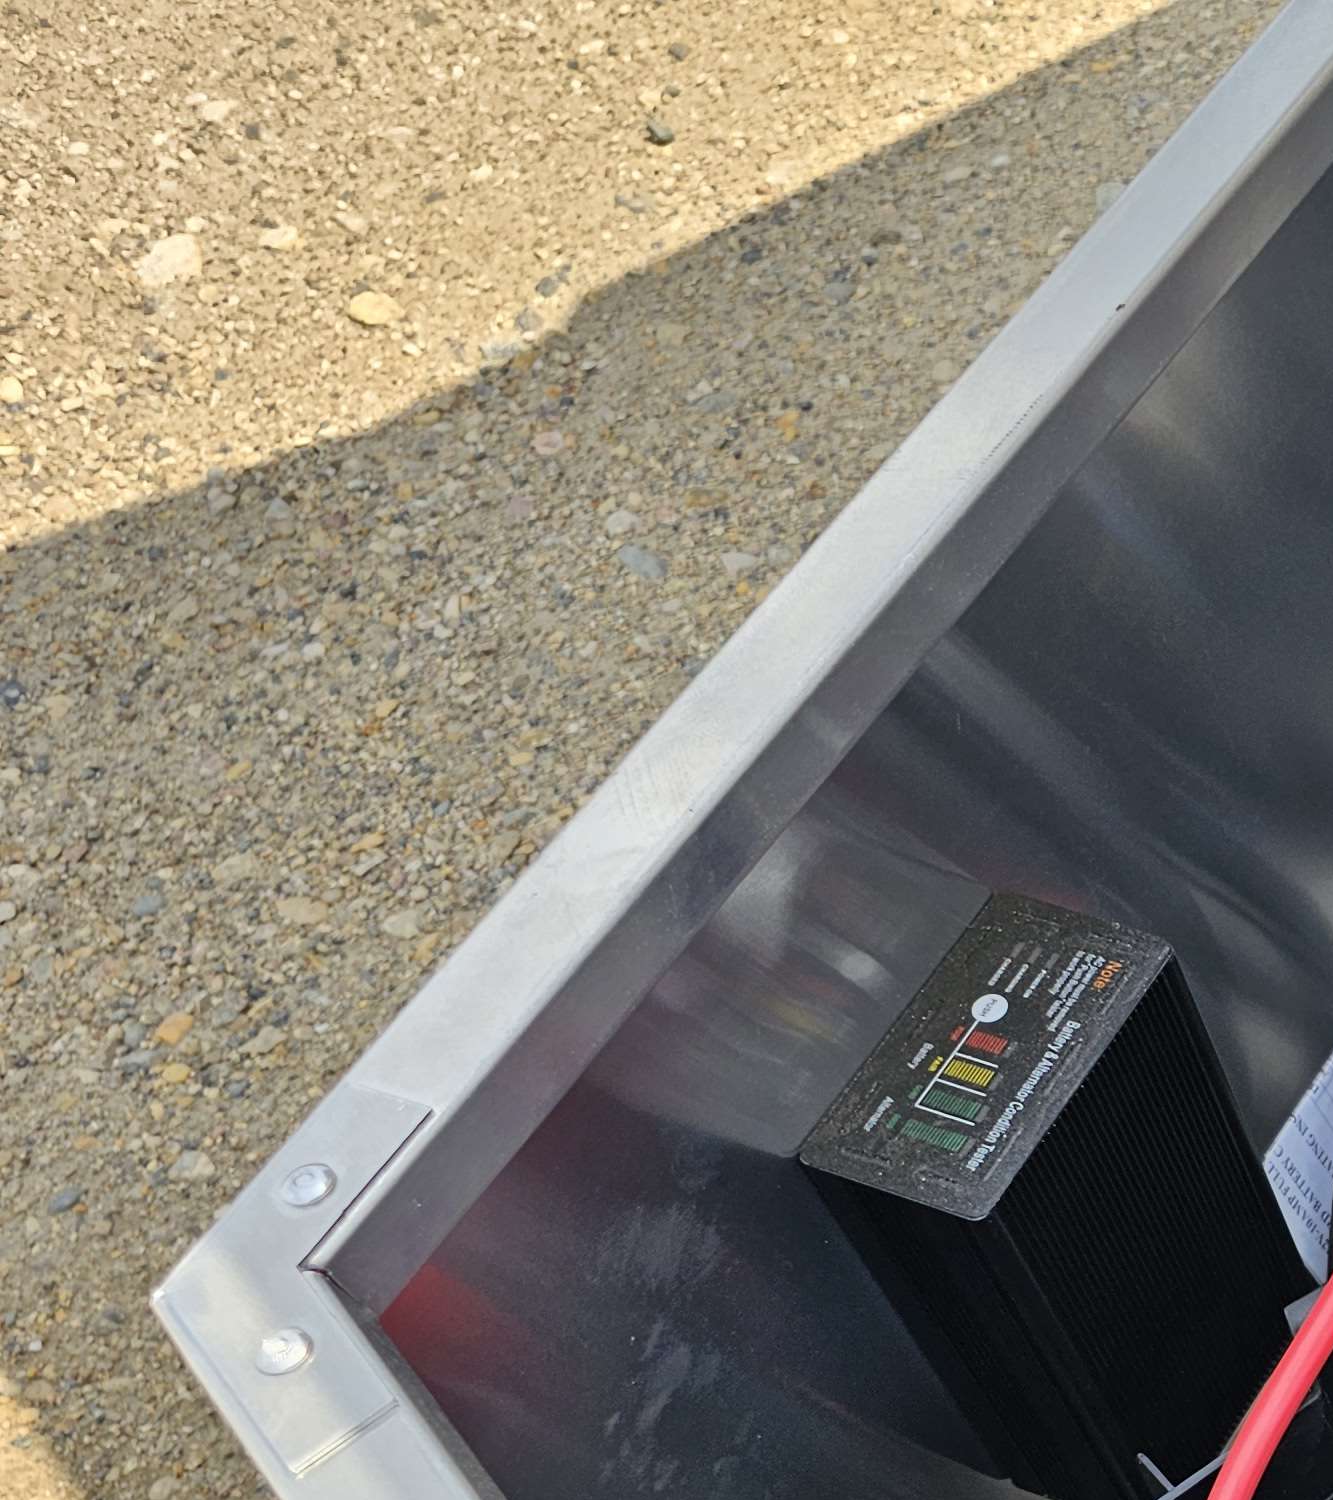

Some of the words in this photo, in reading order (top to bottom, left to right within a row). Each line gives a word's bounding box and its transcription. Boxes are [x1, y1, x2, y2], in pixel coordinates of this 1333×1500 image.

[1088, 959, 1122, 993] Note:
[1044, 1018, 1081, 1053] Battery
[1012, 1056, 1054, 1103] Alternator
[982, 1099, 1025, 1145] Condition
[963, 1141, 996, 1172] Tester
